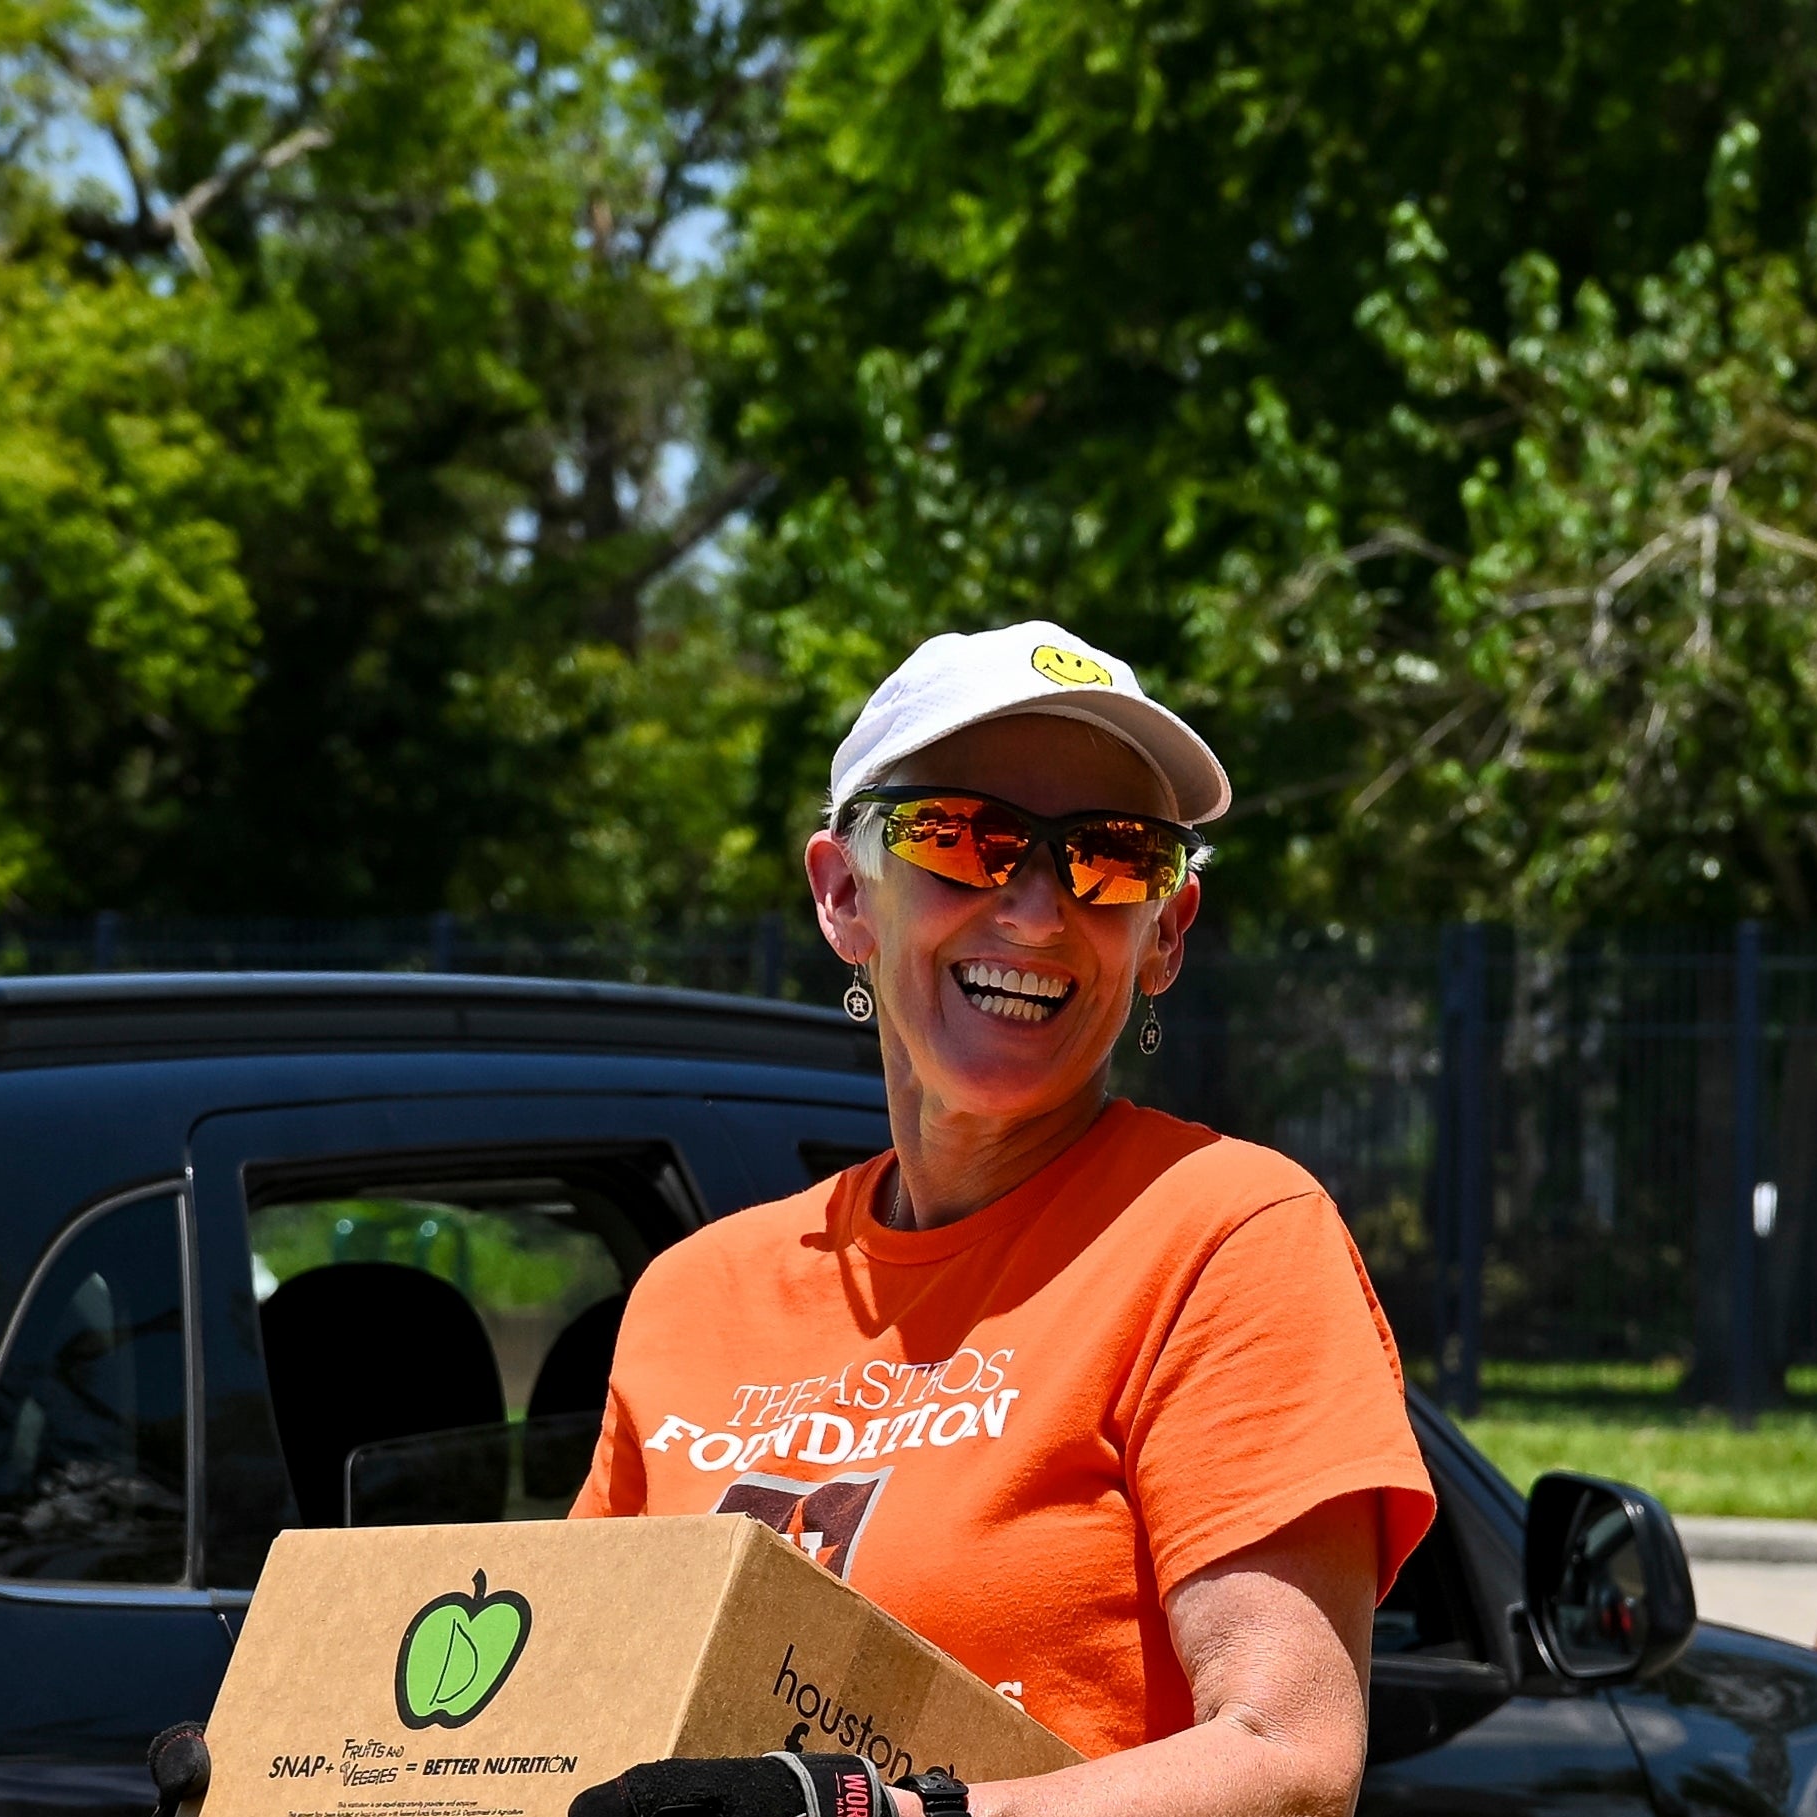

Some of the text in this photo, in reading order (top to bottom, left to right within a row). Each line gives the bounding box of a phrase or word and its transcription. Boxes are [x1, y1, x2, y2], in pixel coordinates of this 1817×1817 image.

[644, 1389, 1020, 1472] FOUNDATION
[773, 1643, 913, 1779] houston
[422, 1757, 481, 1776] BETTER
[482, 1755, 579, 1775] NUTRITION
